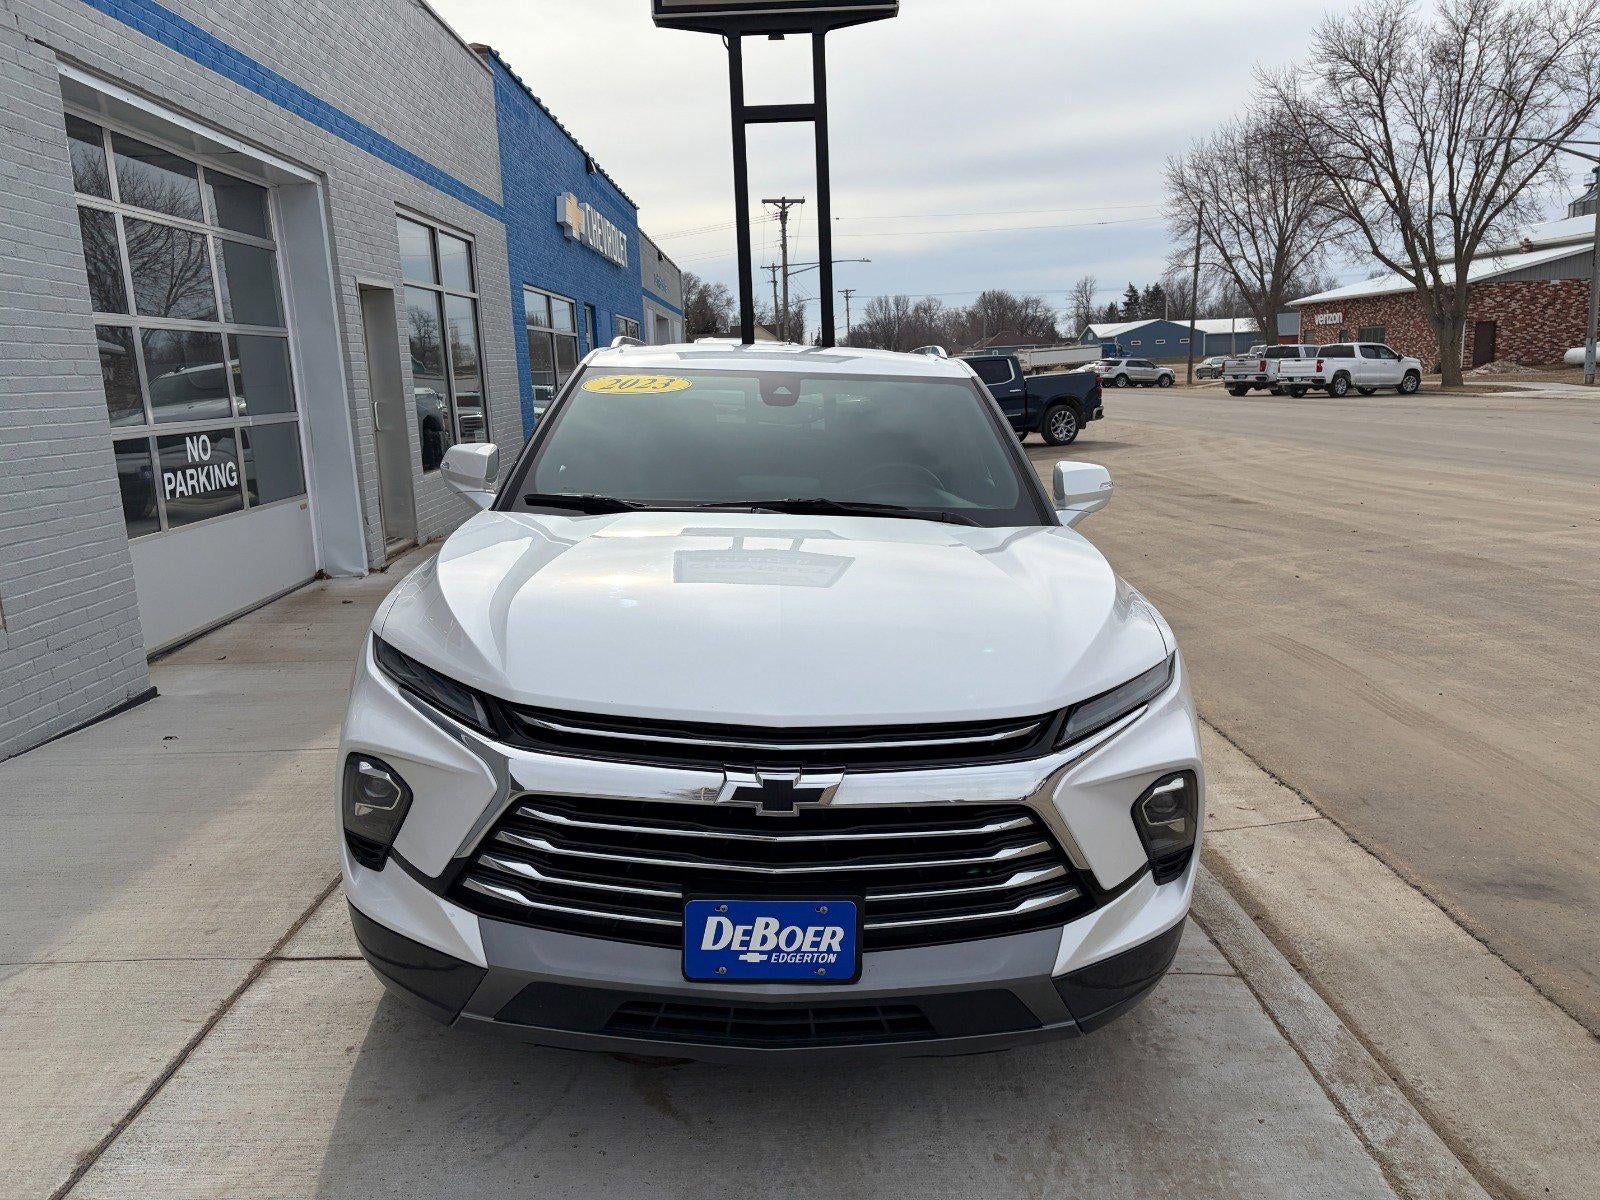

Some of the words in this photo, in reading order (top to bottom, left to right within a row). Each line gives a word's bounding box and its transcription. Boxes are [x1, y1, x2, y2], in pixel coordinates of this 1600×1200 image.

[583, 203, 627, 267] CHEVROLET
[1314, 311, 1343, 325] verizon
[598, 378, 676, 391] 2023
[185, 434, 211, 463] NO
[163, 461, 238, 500] PARKING
[770, 952, 837, 964] EDGERTON
